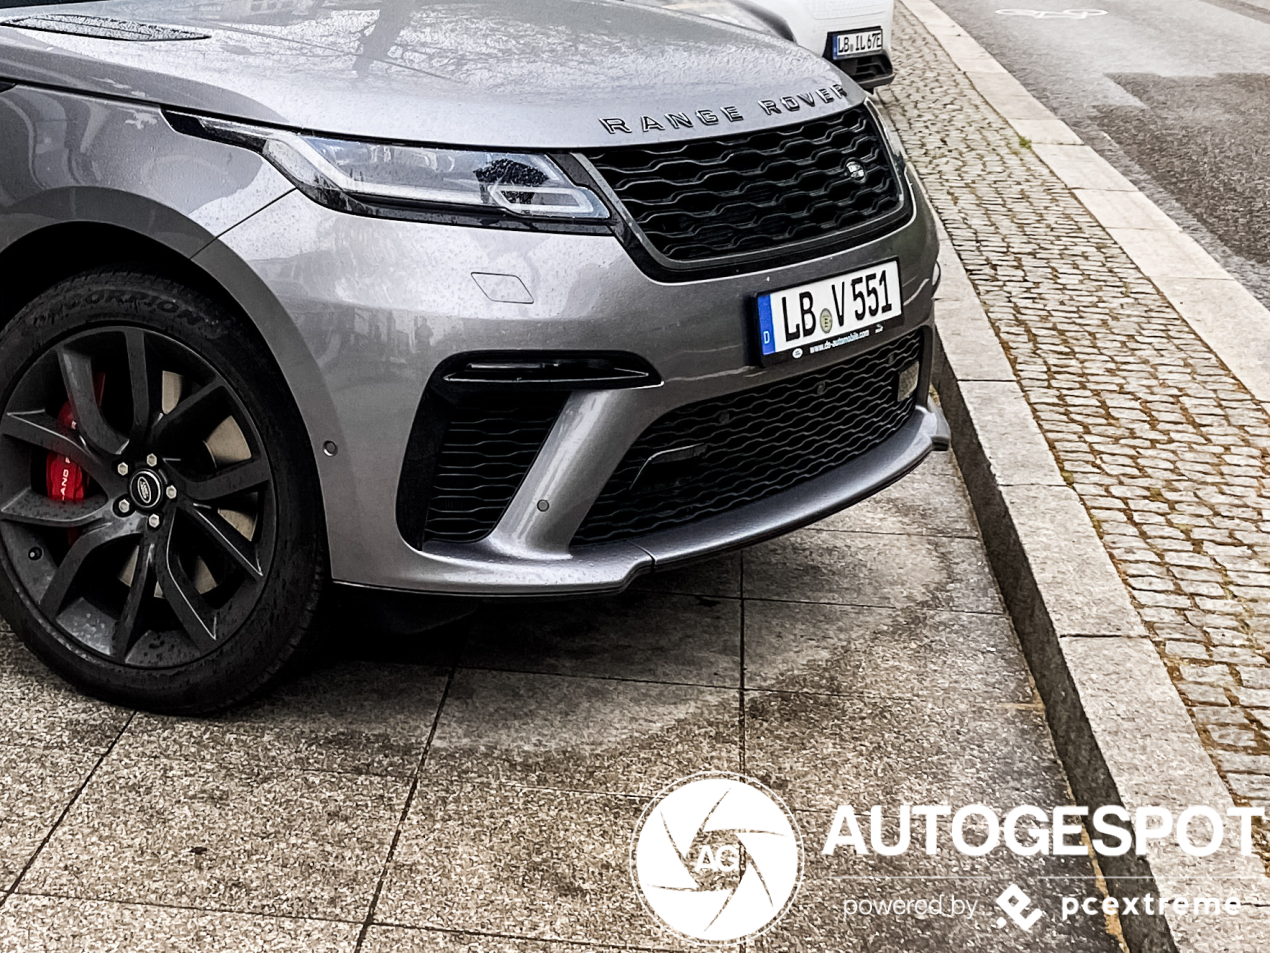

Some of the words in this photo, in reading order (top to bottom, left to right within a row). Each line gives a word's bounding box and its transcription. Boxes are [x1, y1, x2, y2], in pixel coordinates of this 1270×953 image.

[838, 36, 850, 53] LB
[855, 35, 866, 51] IL
[867, 32, 882, 50] 67E
[598, 105, 744, 135] RANGE
[758, 83, 848, 115] ROVER
[781, 290, 817, 343] LB
[831, 281, 845, 327] V
[850, 269, 893, 321] 551
[763, 330, 770, 345] D
